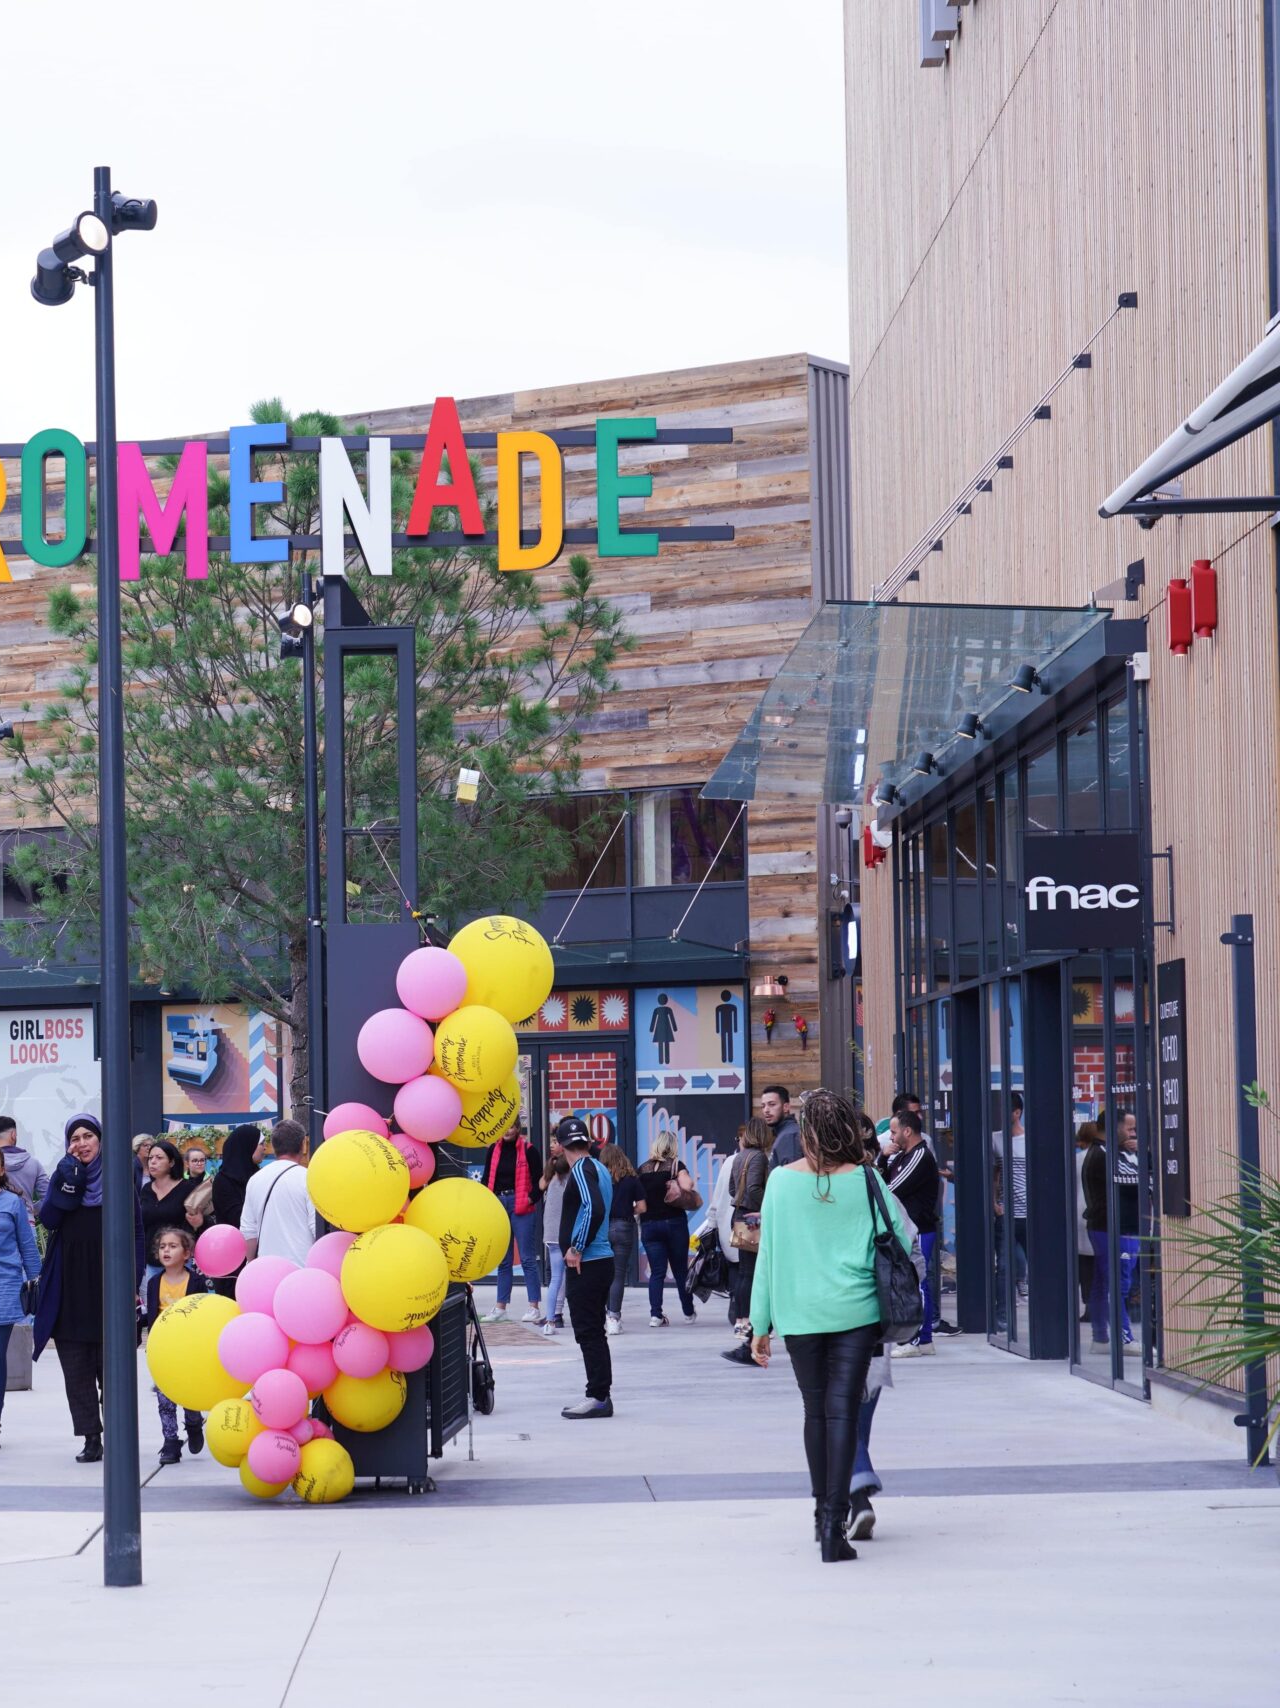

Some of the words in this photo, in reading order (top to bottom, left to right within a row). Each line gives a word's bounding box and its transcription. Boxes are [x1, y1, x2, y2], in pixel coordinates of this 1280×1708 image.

[1025, 876, 1140, 911] fnac
[10, 1018, 84, 1040] GIRLBOSS
[10, 1043, 59, 1064] LOOKS
[459, 1085, 507, 1136] Shopping
[450, 1235, 478, 1279] Promenade
